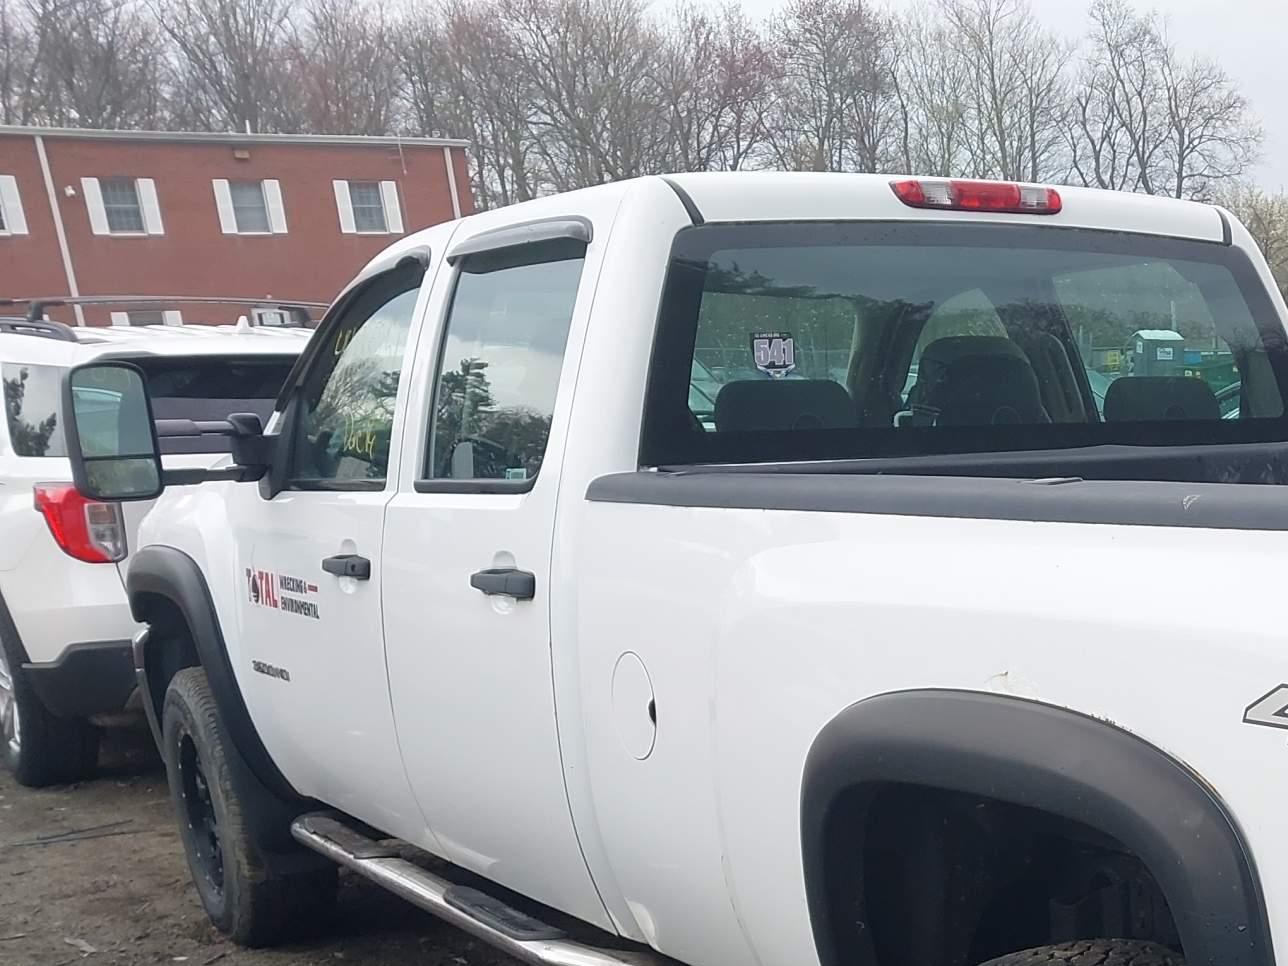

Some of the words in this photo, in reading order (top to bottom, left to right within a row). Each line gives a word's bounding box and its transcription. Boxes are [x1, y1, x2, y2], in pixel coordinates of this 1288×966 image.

[754, 338, 793, 366] 541
[245, 567, 278, 608] TOTAL
[279, 574, 303, 594] WRECKING
[280, 595, 320, 620] ENVIRONMENTAL
